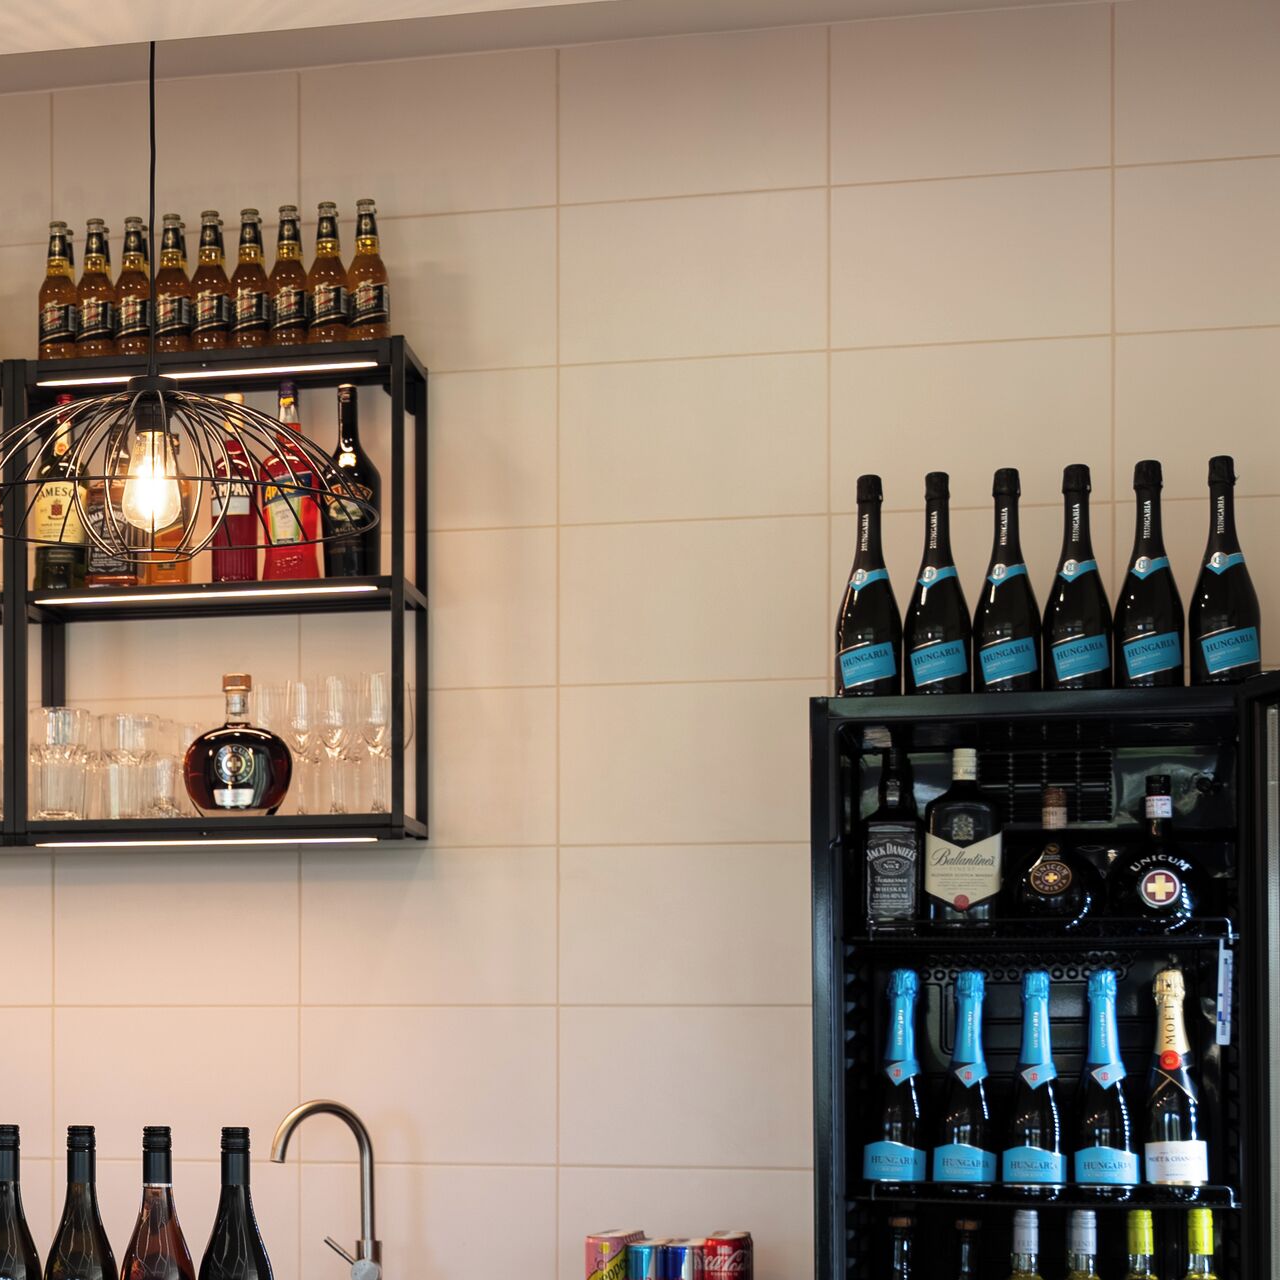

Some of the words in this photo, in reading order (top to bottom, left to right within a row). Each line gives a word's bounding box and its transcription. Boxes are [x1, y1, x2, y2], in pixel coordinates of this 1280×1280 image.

[982, 642, 1030, 664] HUNGARIA
[1056, 640, 1104, 661] HUNGARIA
[1127, 638, 1174, 659] HUNGARIA
[1205, 633, 1254, 655] HUNGARIA
[843, 647, 889, 668] HUNGARIA
[913, 646, 961, 666] HUNGARIA
[866, 845, 886, 861] JACK
[1130, 854, 1192, 871] UNICUM
